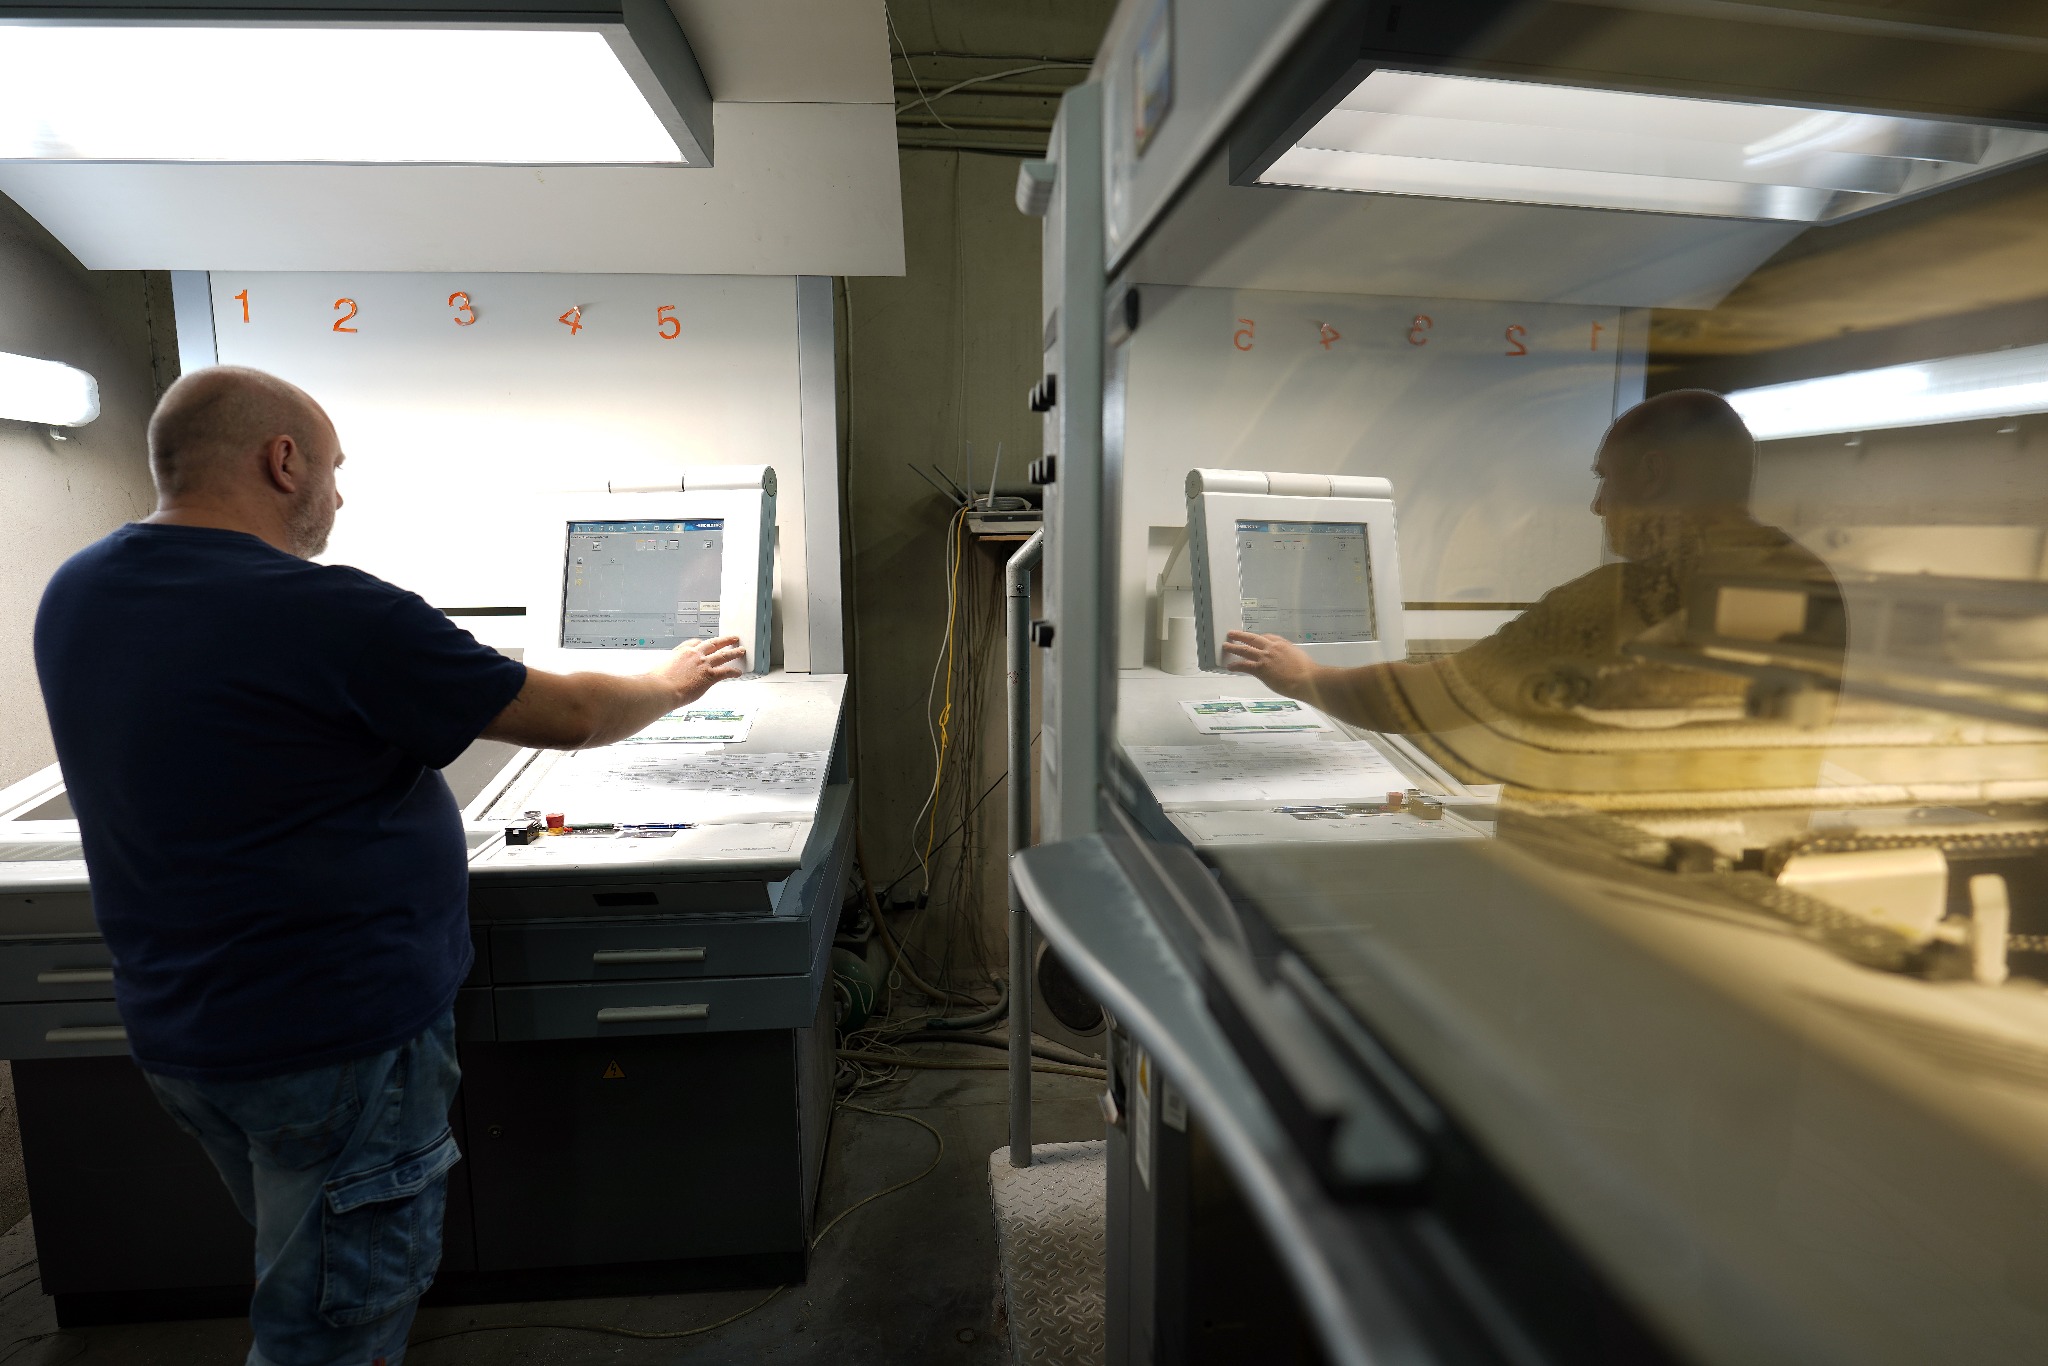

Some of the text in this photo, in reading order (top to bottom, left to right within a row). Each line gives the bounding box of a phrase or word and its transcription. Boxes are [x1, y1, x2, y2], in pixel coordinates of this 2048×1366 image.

[234, 289, 681, 340] 1 2 3 4 5
